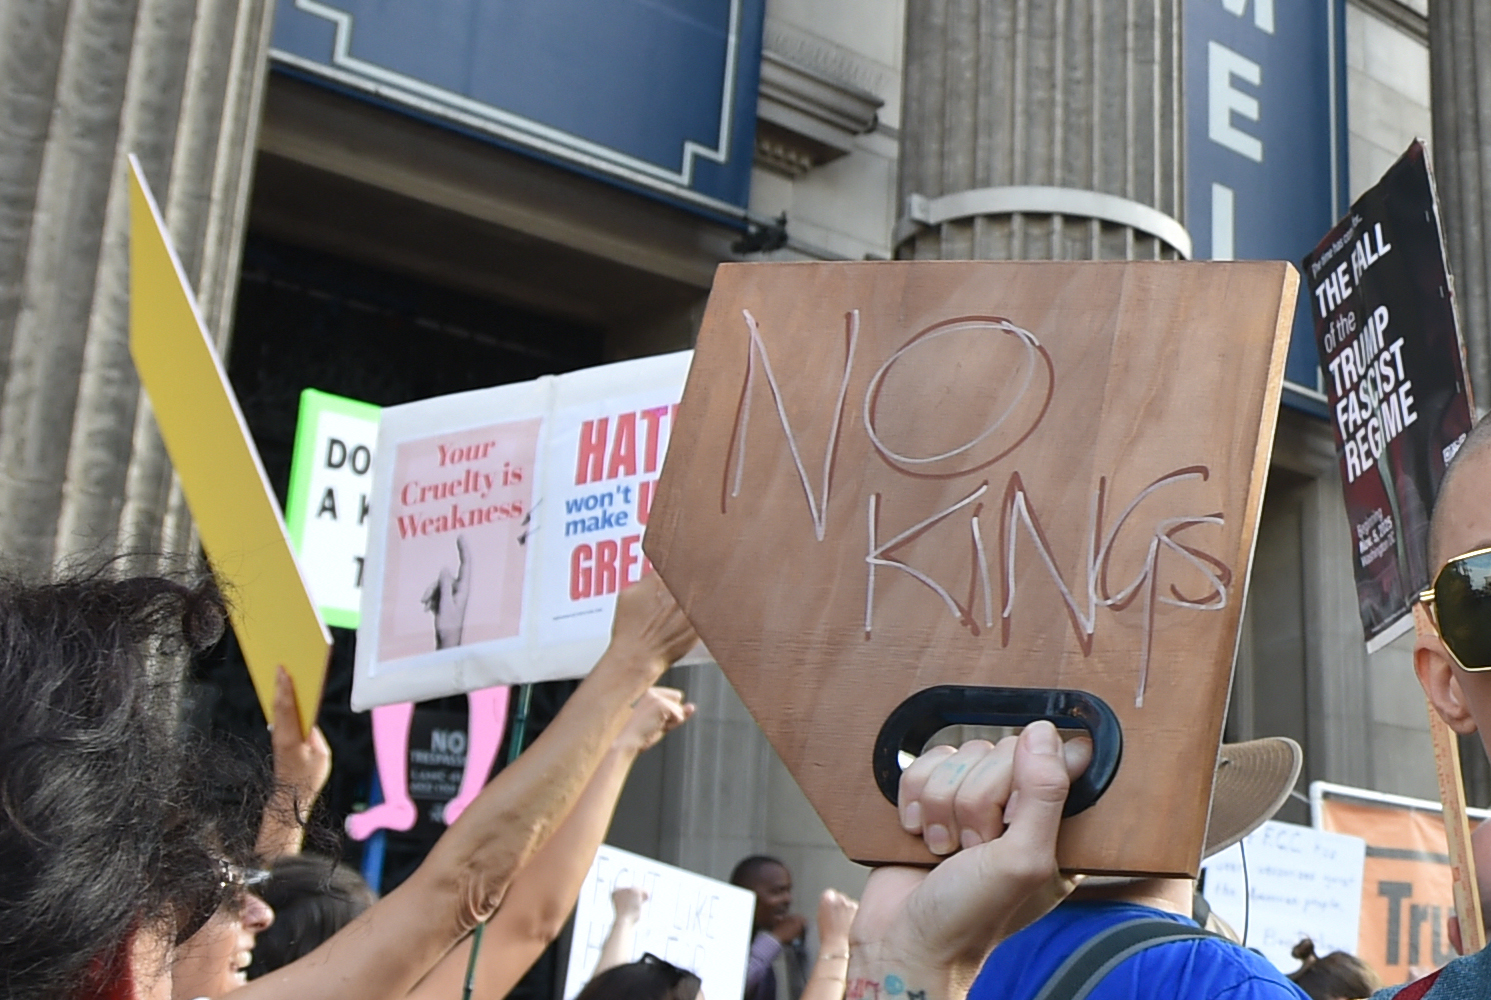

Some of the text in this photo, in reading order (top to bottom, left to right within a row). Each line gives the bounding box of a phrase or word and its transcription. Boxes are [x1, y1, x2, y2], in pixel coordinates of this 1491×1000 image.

[1315, 222, 1392, 318] THE FALL
[1324, 311, 1356, 353] of the
[1329, 305, 1389, 397] TRUMP
[1336, 337, 1405, 440] FASCIST
[575, 403, 681, 486] HAT
[721, 308, 1054, 541] NO
[1344, 380, 1418, 483] REGIME
[438, 441, 496, 466] Your
[317, 486, 338, 520] A
[401, 461, 522, 506] Cruelty is
[565, 485, 632, 515] won't
[397, 500, 523, 540] Weakness
[565, 509, 629, 538] make
[431, 730, 467, 754] NO
